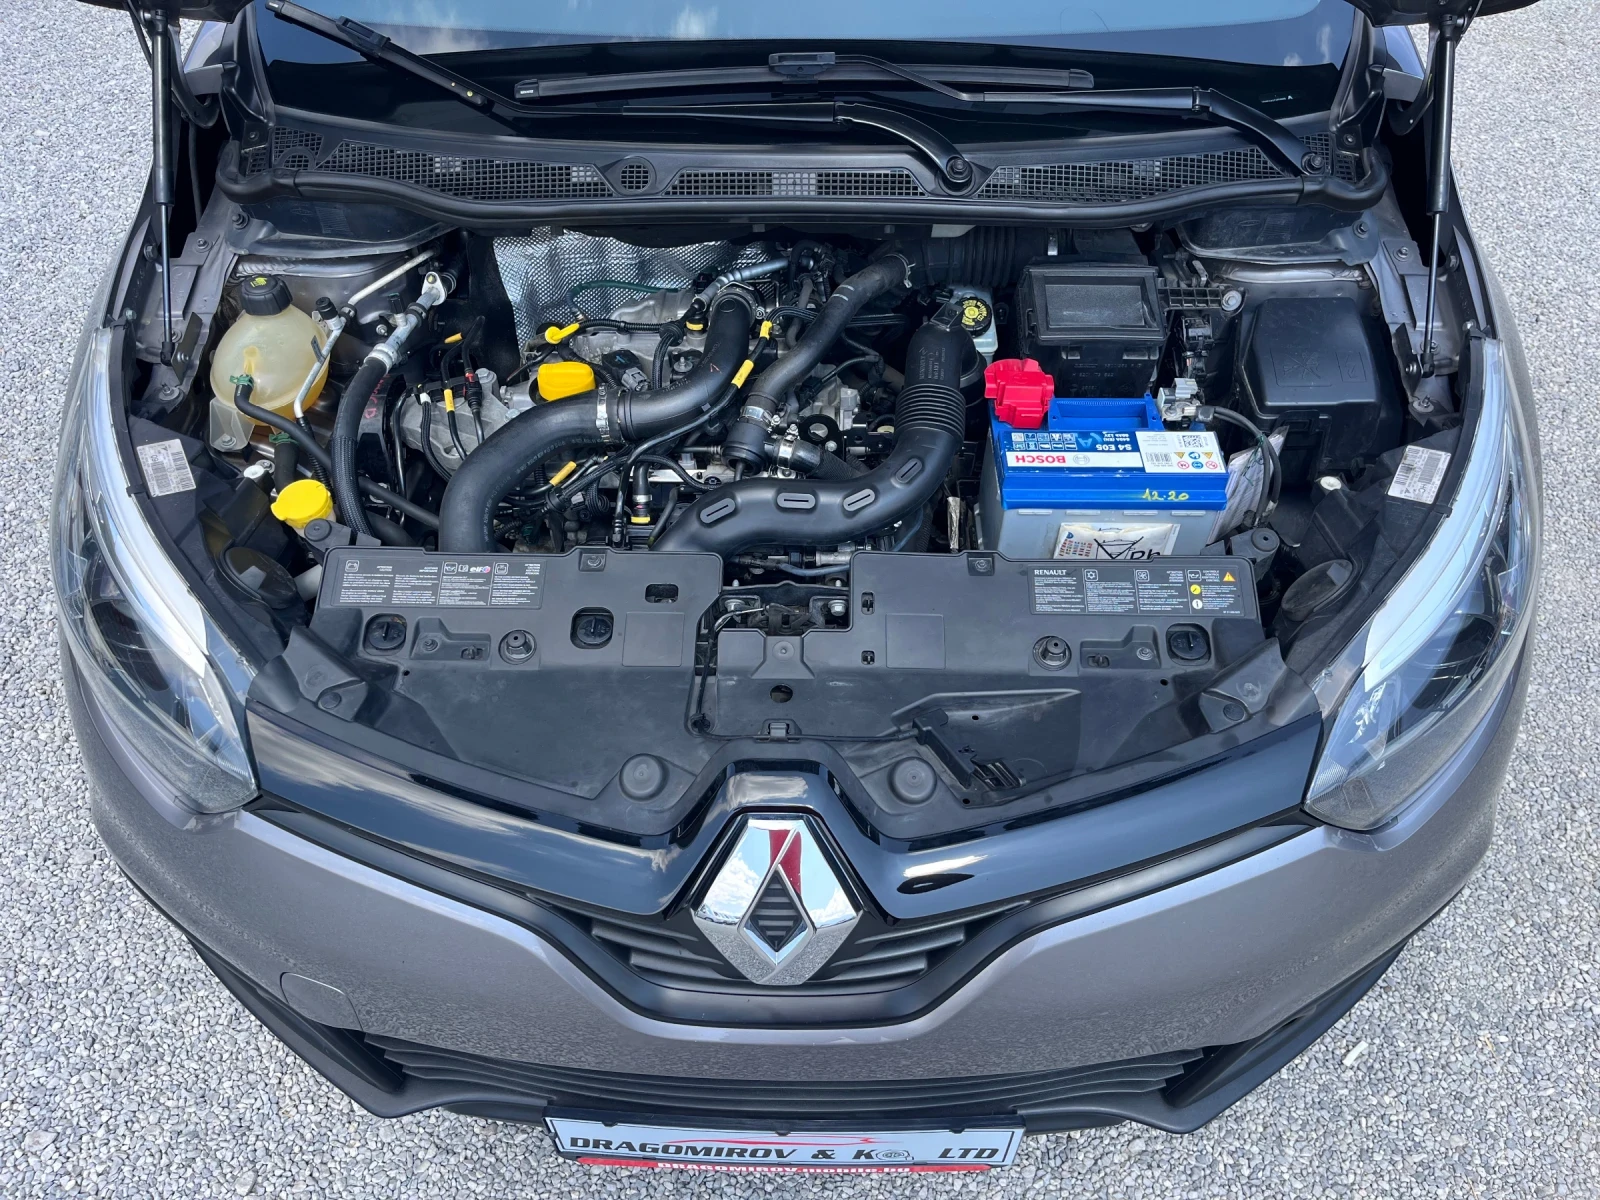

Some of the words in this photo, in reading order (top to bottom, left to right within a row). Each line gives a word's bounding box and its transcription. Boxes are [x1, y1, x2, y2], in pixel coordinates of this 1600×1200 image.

[1095, 443, 1115, 451] E05
[1118, 443, 1132, 451] S4
[1015, 455, 1067, 464] BOSCH
[569, 1136, 798, 1159] DRAGOMIROV
[811, 1149, 836, 1160] &
[938, 1147, 1000, 1159] LTD
